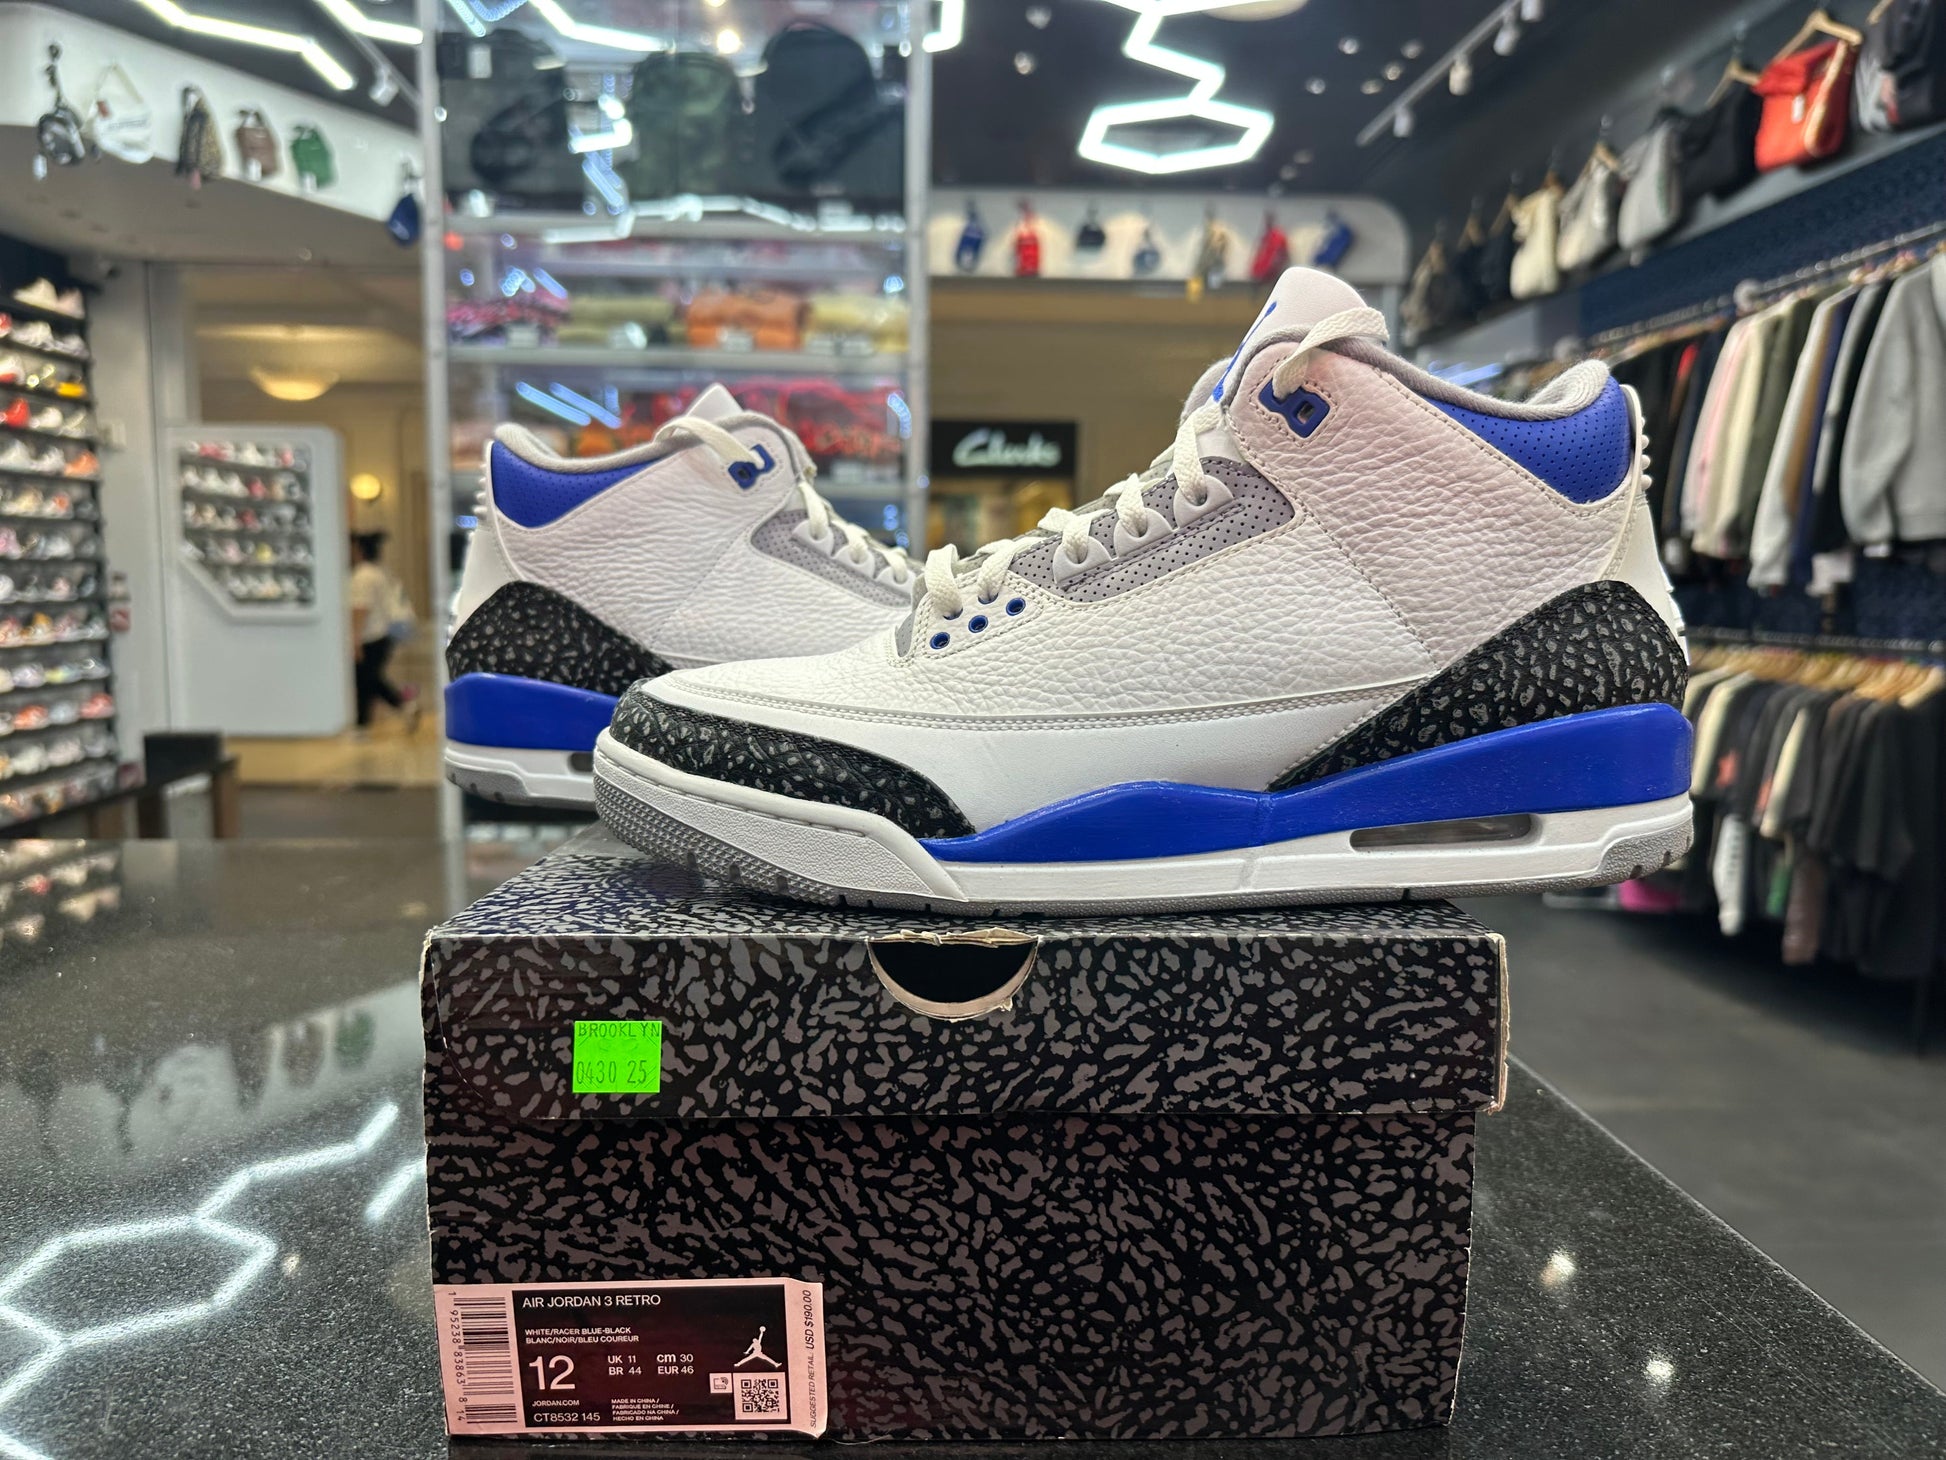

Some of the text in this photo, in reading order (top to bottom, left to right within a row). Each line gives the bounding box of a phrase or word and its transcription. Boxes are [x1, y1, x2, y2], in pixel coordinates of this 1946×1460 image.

[578, 1022, 660, 1038] BROOKLYN
[626, 1059, 648, 1084] 25
[522, 1294, 661, 1308] AIR JORDAN 3 RETRO
[802, 1289, 814, 1328] $190.00
[450, 1309, 461, 1344] 95238
[525, 1327, 632, 1336] WHITE/RACER BLUE-BLACK
[526, 1335, 639, 1345] BLANC/NOIR/BLEU COUREUR
[805, 1329, 815, 1350] USD
[607, 1355, 637, 1364] UK 11
[656, 1353, 694, 1363] cm 30
[454, 1351, 466, 1385] 83863
[529, 1355, 576, 1390] 12
[608, 1366, 642, 1375] BR 44
[657, 1365, 695, 1375] EUR 46
[532, 1399, 580, 1407] JORDAN.COM
[807, 1380, 817, 1428] SUGGESTED
[533, 1412, 601, 1423] CT8532 145
